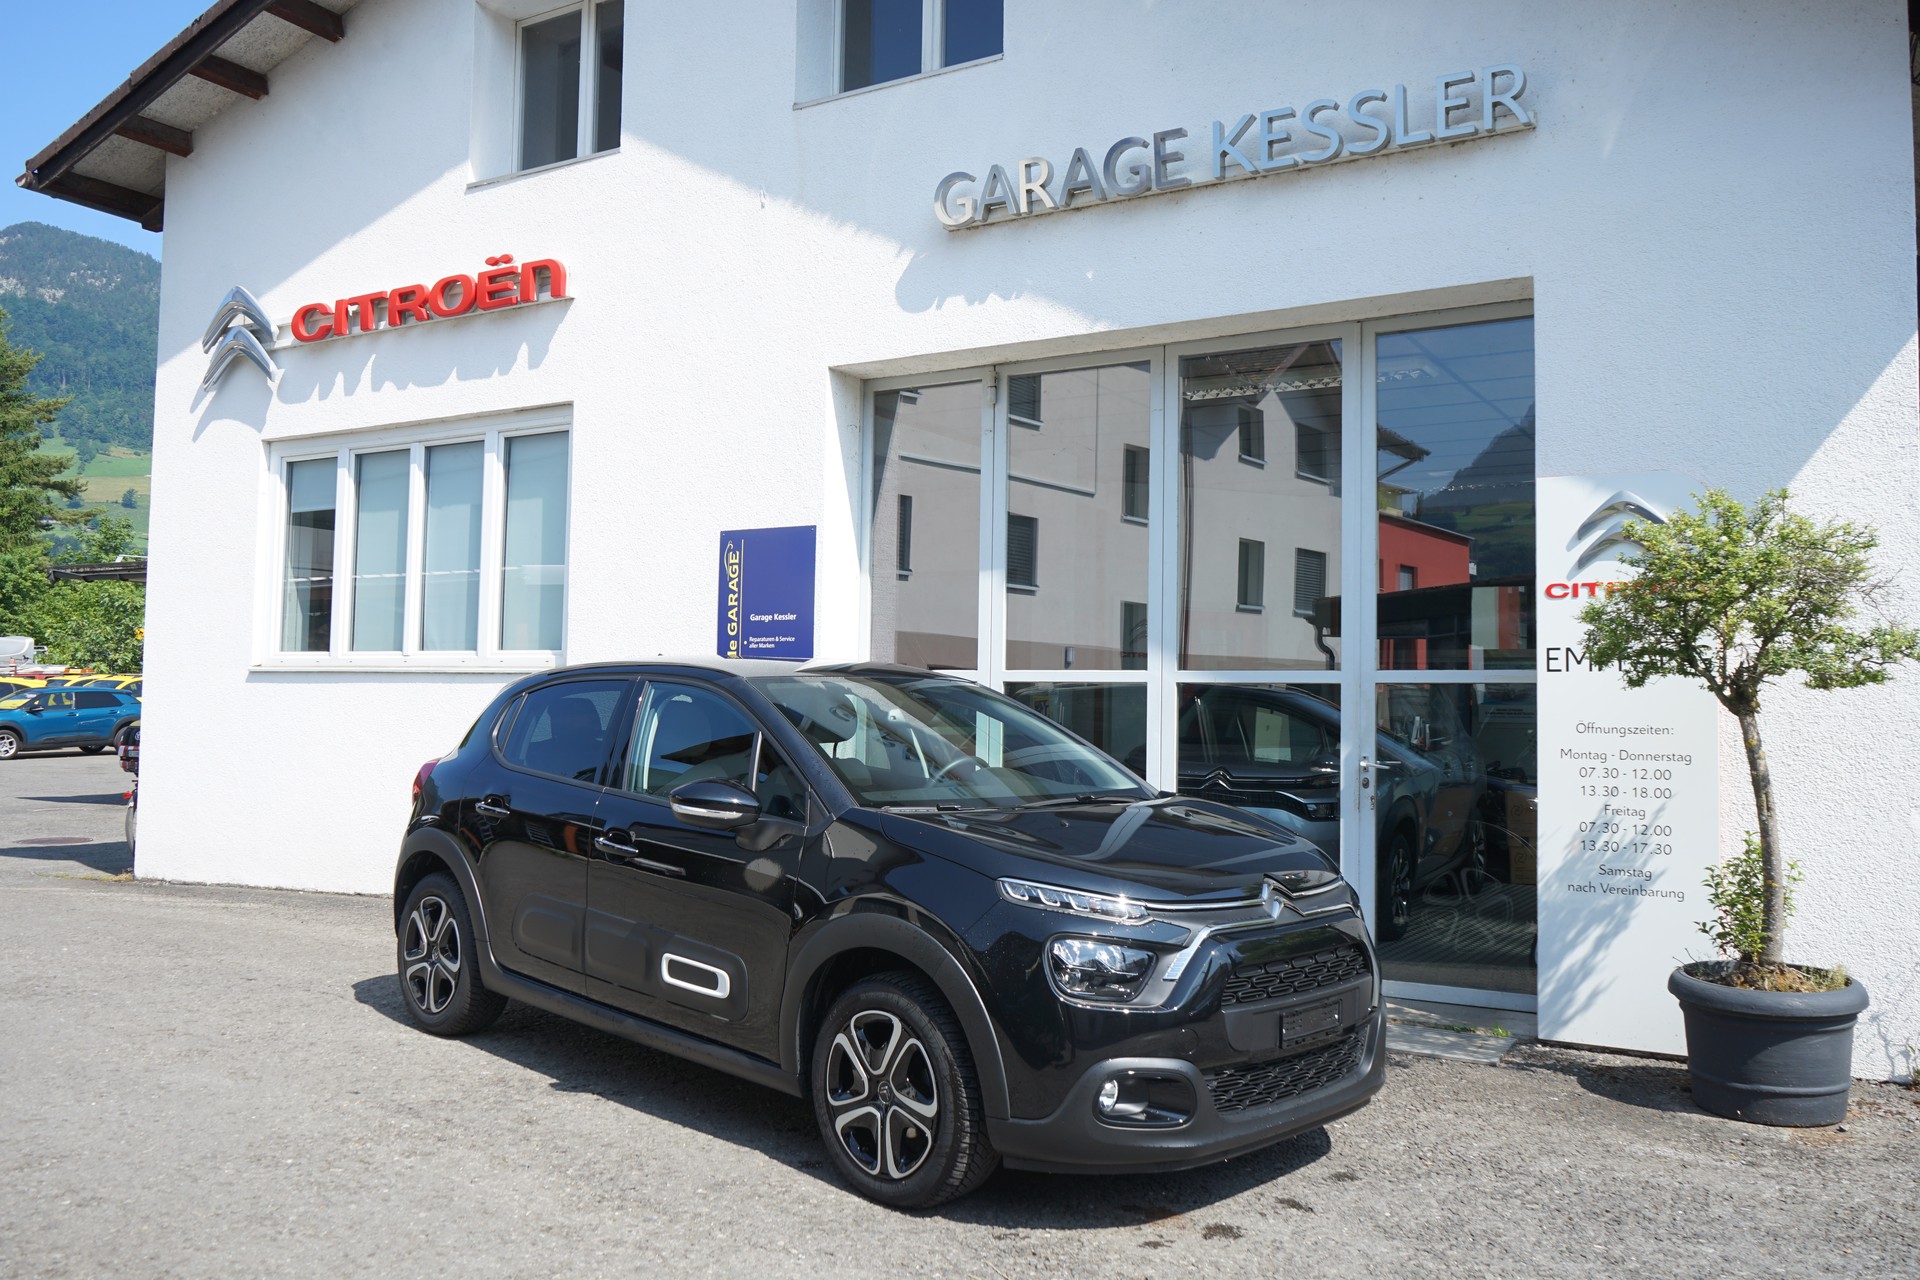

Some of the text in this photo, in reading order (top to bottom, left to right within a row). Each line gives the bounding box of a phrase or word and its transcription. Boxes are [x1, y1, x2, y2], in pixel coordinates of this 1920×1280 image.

[933, 62, 1534, 228] GARAGE KESSLER
[727, 551, 739, 636] GARAGE
[749, 612, 797, 622] Garage Kessler
[1575, 720, 1674, 738] Öffnungszeiten:
[1560, 748, 1607, 763] Montag
[1619, 749, 1692, 766] Donnerstag
[1579, 766, 1619, 779] 07.30
[1632, 768, 1672, 781] 12.00
[1581, 785, 1619, 797] 13.30
[1632, 787, 1672, 799] 18.00
[1604, 804, 1646, 820] Freitag
[1579, 821, 1619, 834] 07.30
[1632, 824, 1672, 837] 12.00
[1581, 840, 1619, 852] 13.30
[1632, 842, 1672, 855] 17.30
[1598, 864, 1652, 881] Samstag
[1567, 881, 1685, 902] nach Vereinbarung
